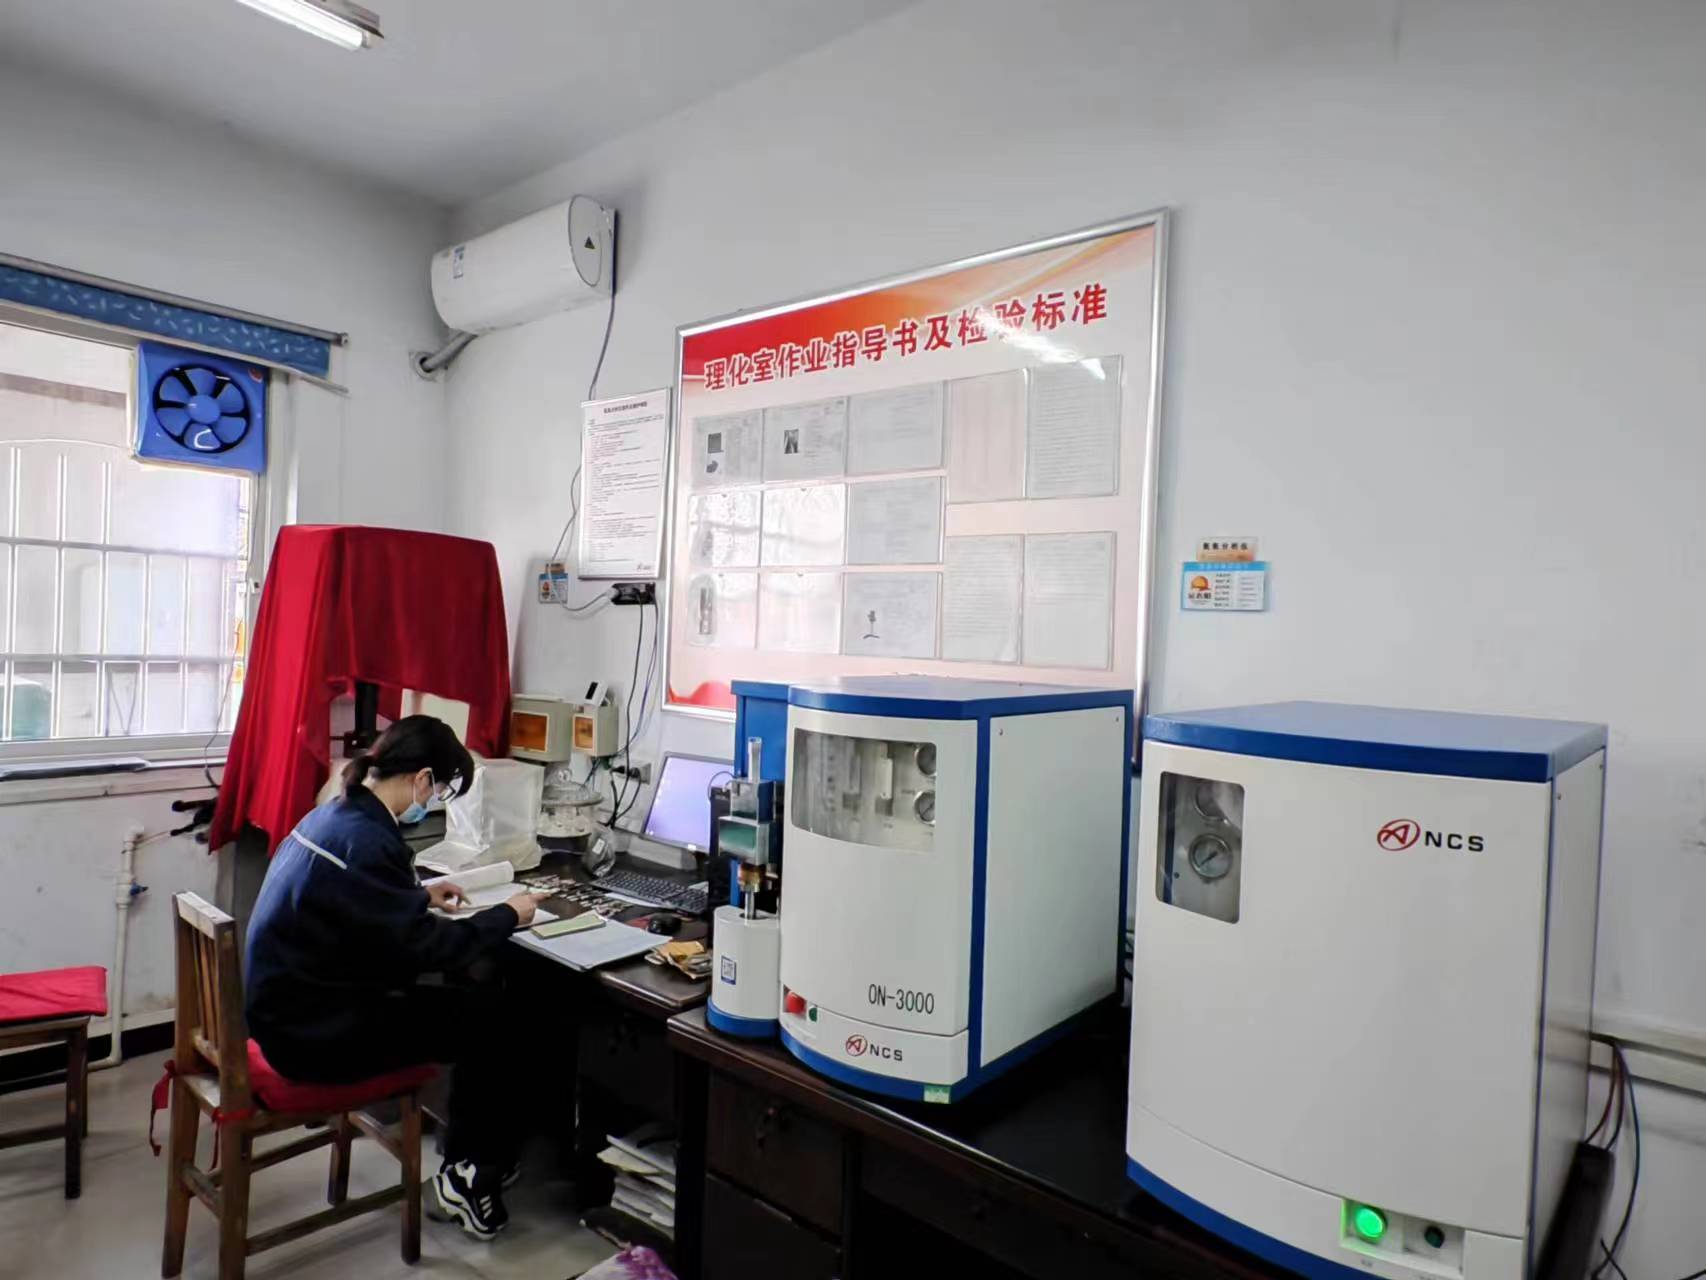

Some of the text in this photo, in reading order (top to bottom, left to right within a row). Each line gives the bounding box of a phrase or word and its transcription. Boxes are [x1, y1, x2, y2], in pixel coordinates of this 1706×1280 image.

[704, 283, 1108, 391] 理化室作业指导书及检验标准
[1425, 830, 1484, 852] NCS
[868, 984, 935, 1014] ON-3000
[869, 1044, 903, 1061] NCS
